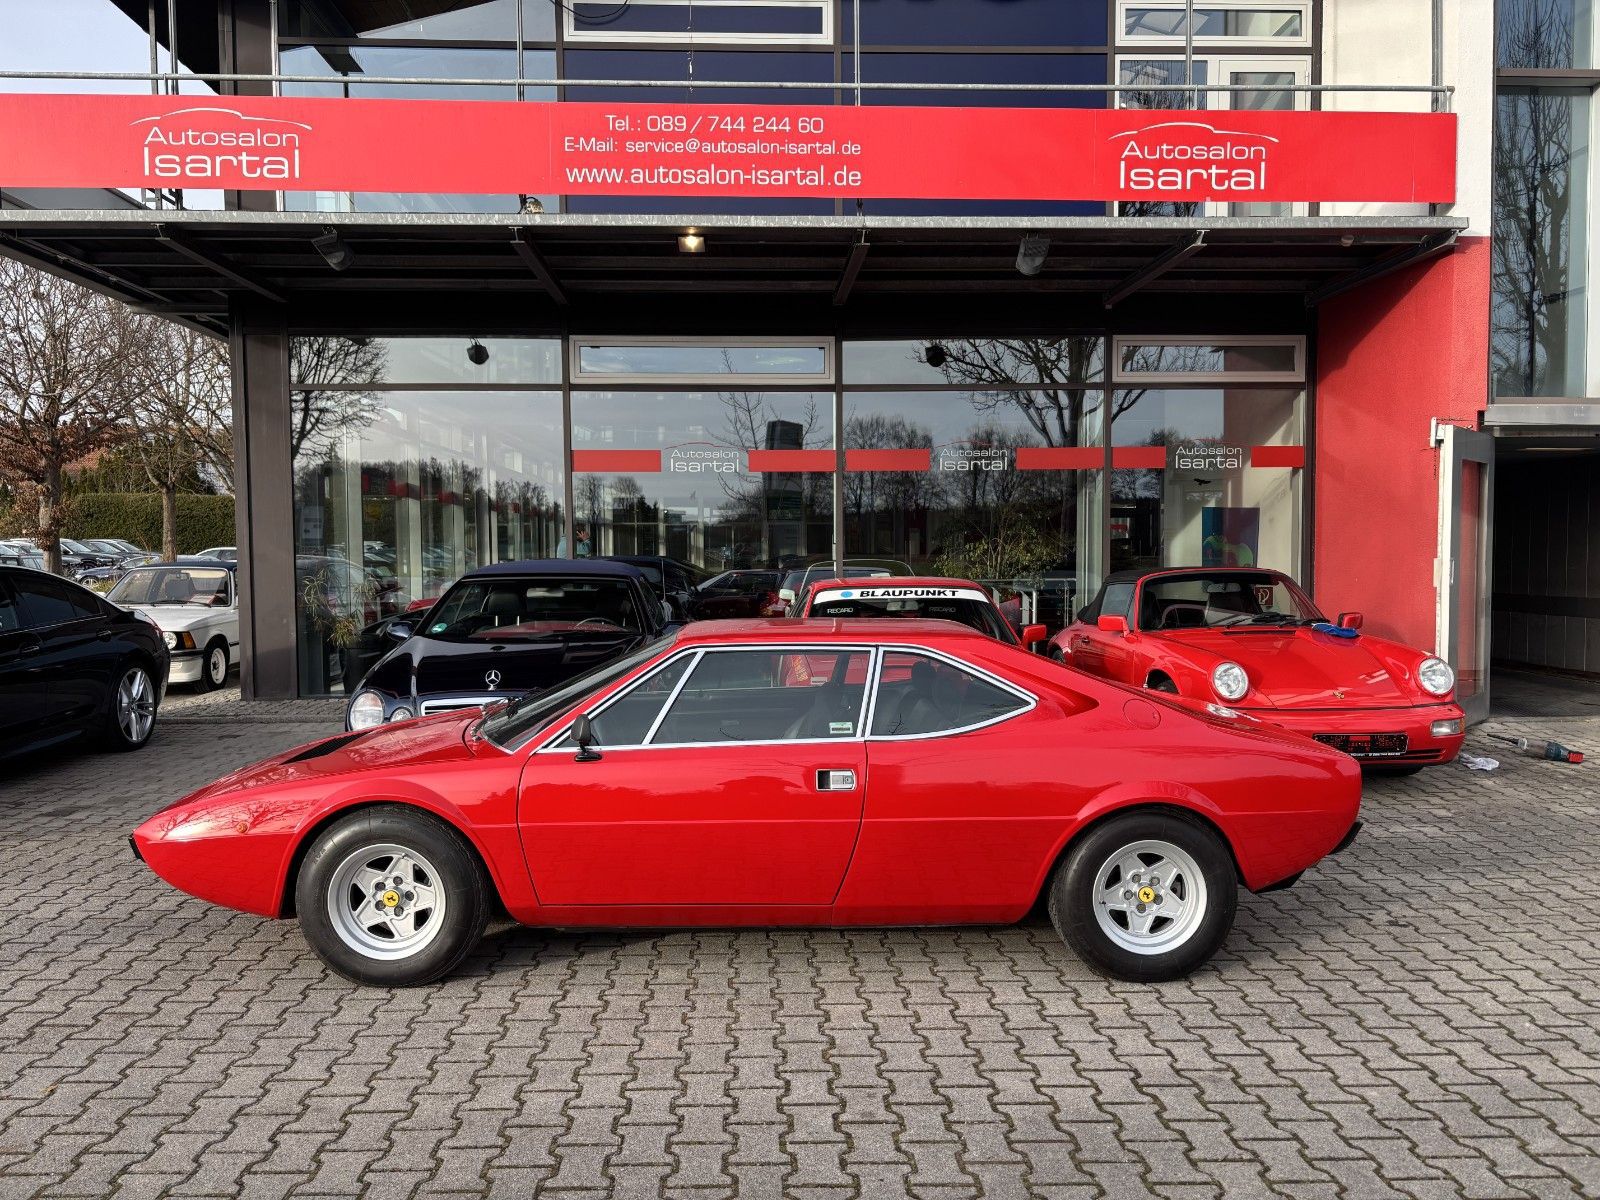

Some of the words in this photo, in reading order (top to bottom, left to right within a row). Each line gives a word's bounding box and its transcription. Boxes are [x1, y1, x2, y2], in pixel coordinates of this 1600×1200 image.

[605, 115, 641, 132] Tel.:
[752, 116, 792, 133] 244
[799, 117, 824, 134] 60
[144, 126, 299, 147] Autosalon
[564, 137, 618, 153] E-Mail:
[625, 138, 861, 155] service@autosalon-isartal.de
[1121, 141, 1266, 160] Autosalon
[143, 146, 300, 179] Isartal
[566, 164, 862, 187] www.autosalon-isartal.de
[1119, 160, 1266, 191] Isartal
[671, 449, 739, 459] Autosalon
[940, 447, 1008, 457] Autosalon
[1175, 445, 1242, 455] Autosalon
[670, 458, 739, 473] Isartal
[940, 456, 1008, 471] Isartal
[1175, 454, 1242, 469] Isartal
[859, 589, 959, 598] BLAUPUNKT
